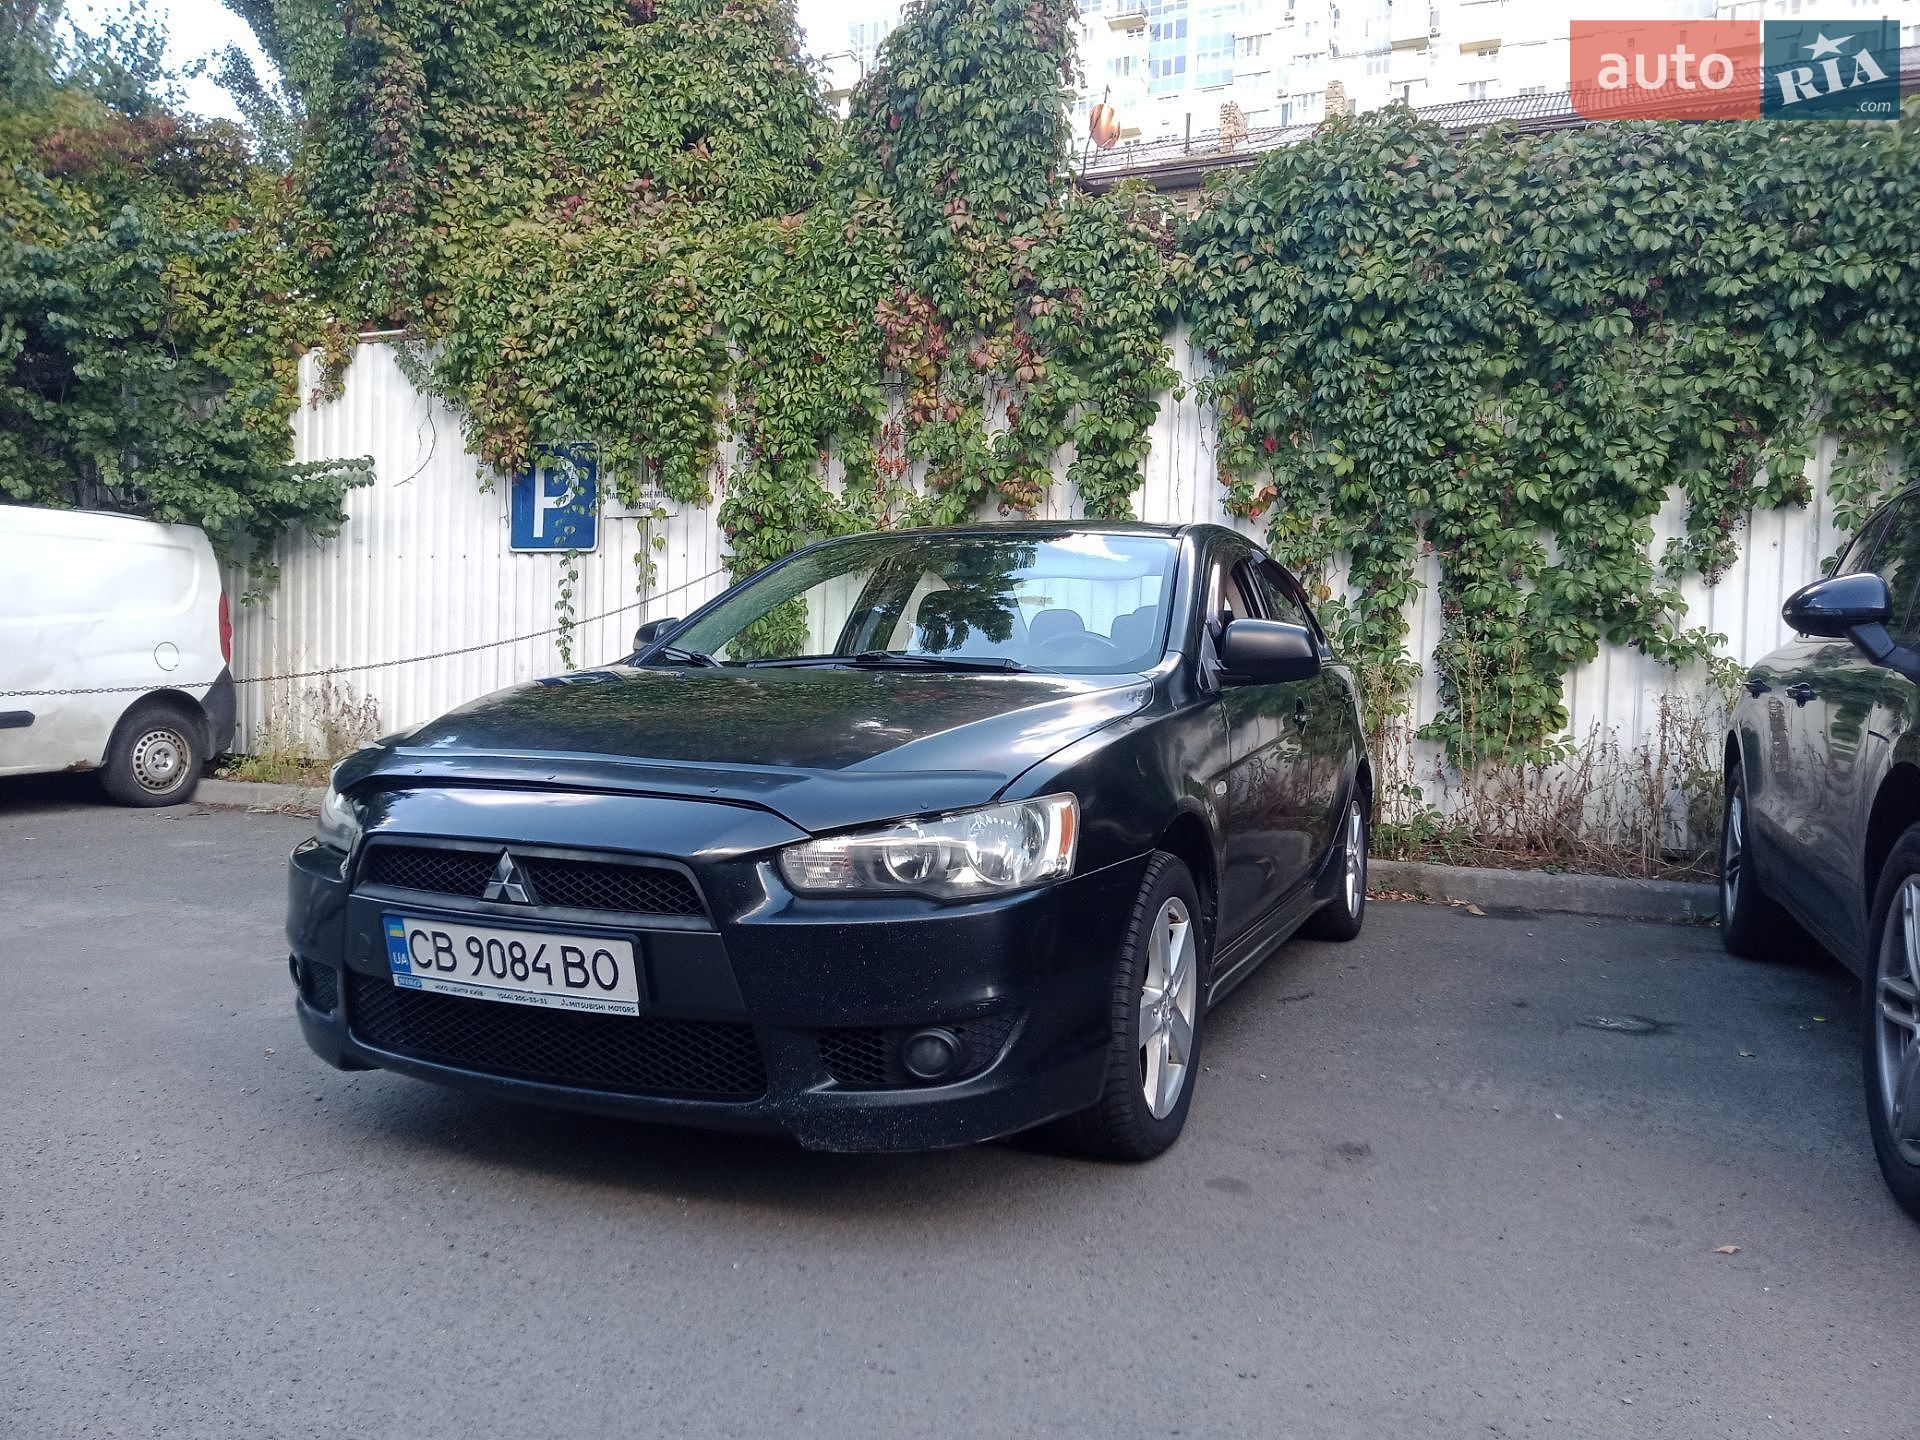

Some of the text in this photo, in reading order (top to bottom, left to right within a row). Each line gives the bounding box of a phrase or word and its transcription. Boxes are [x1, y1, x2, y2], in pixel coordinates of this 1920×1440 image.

[533, 456, 579, 538] P
[393, 952, 409, 965] UA
[409, 929, 619, 991] CB 9084 BO
[568, 1001, 636, 1014] MITSUBISHI MOTORS
